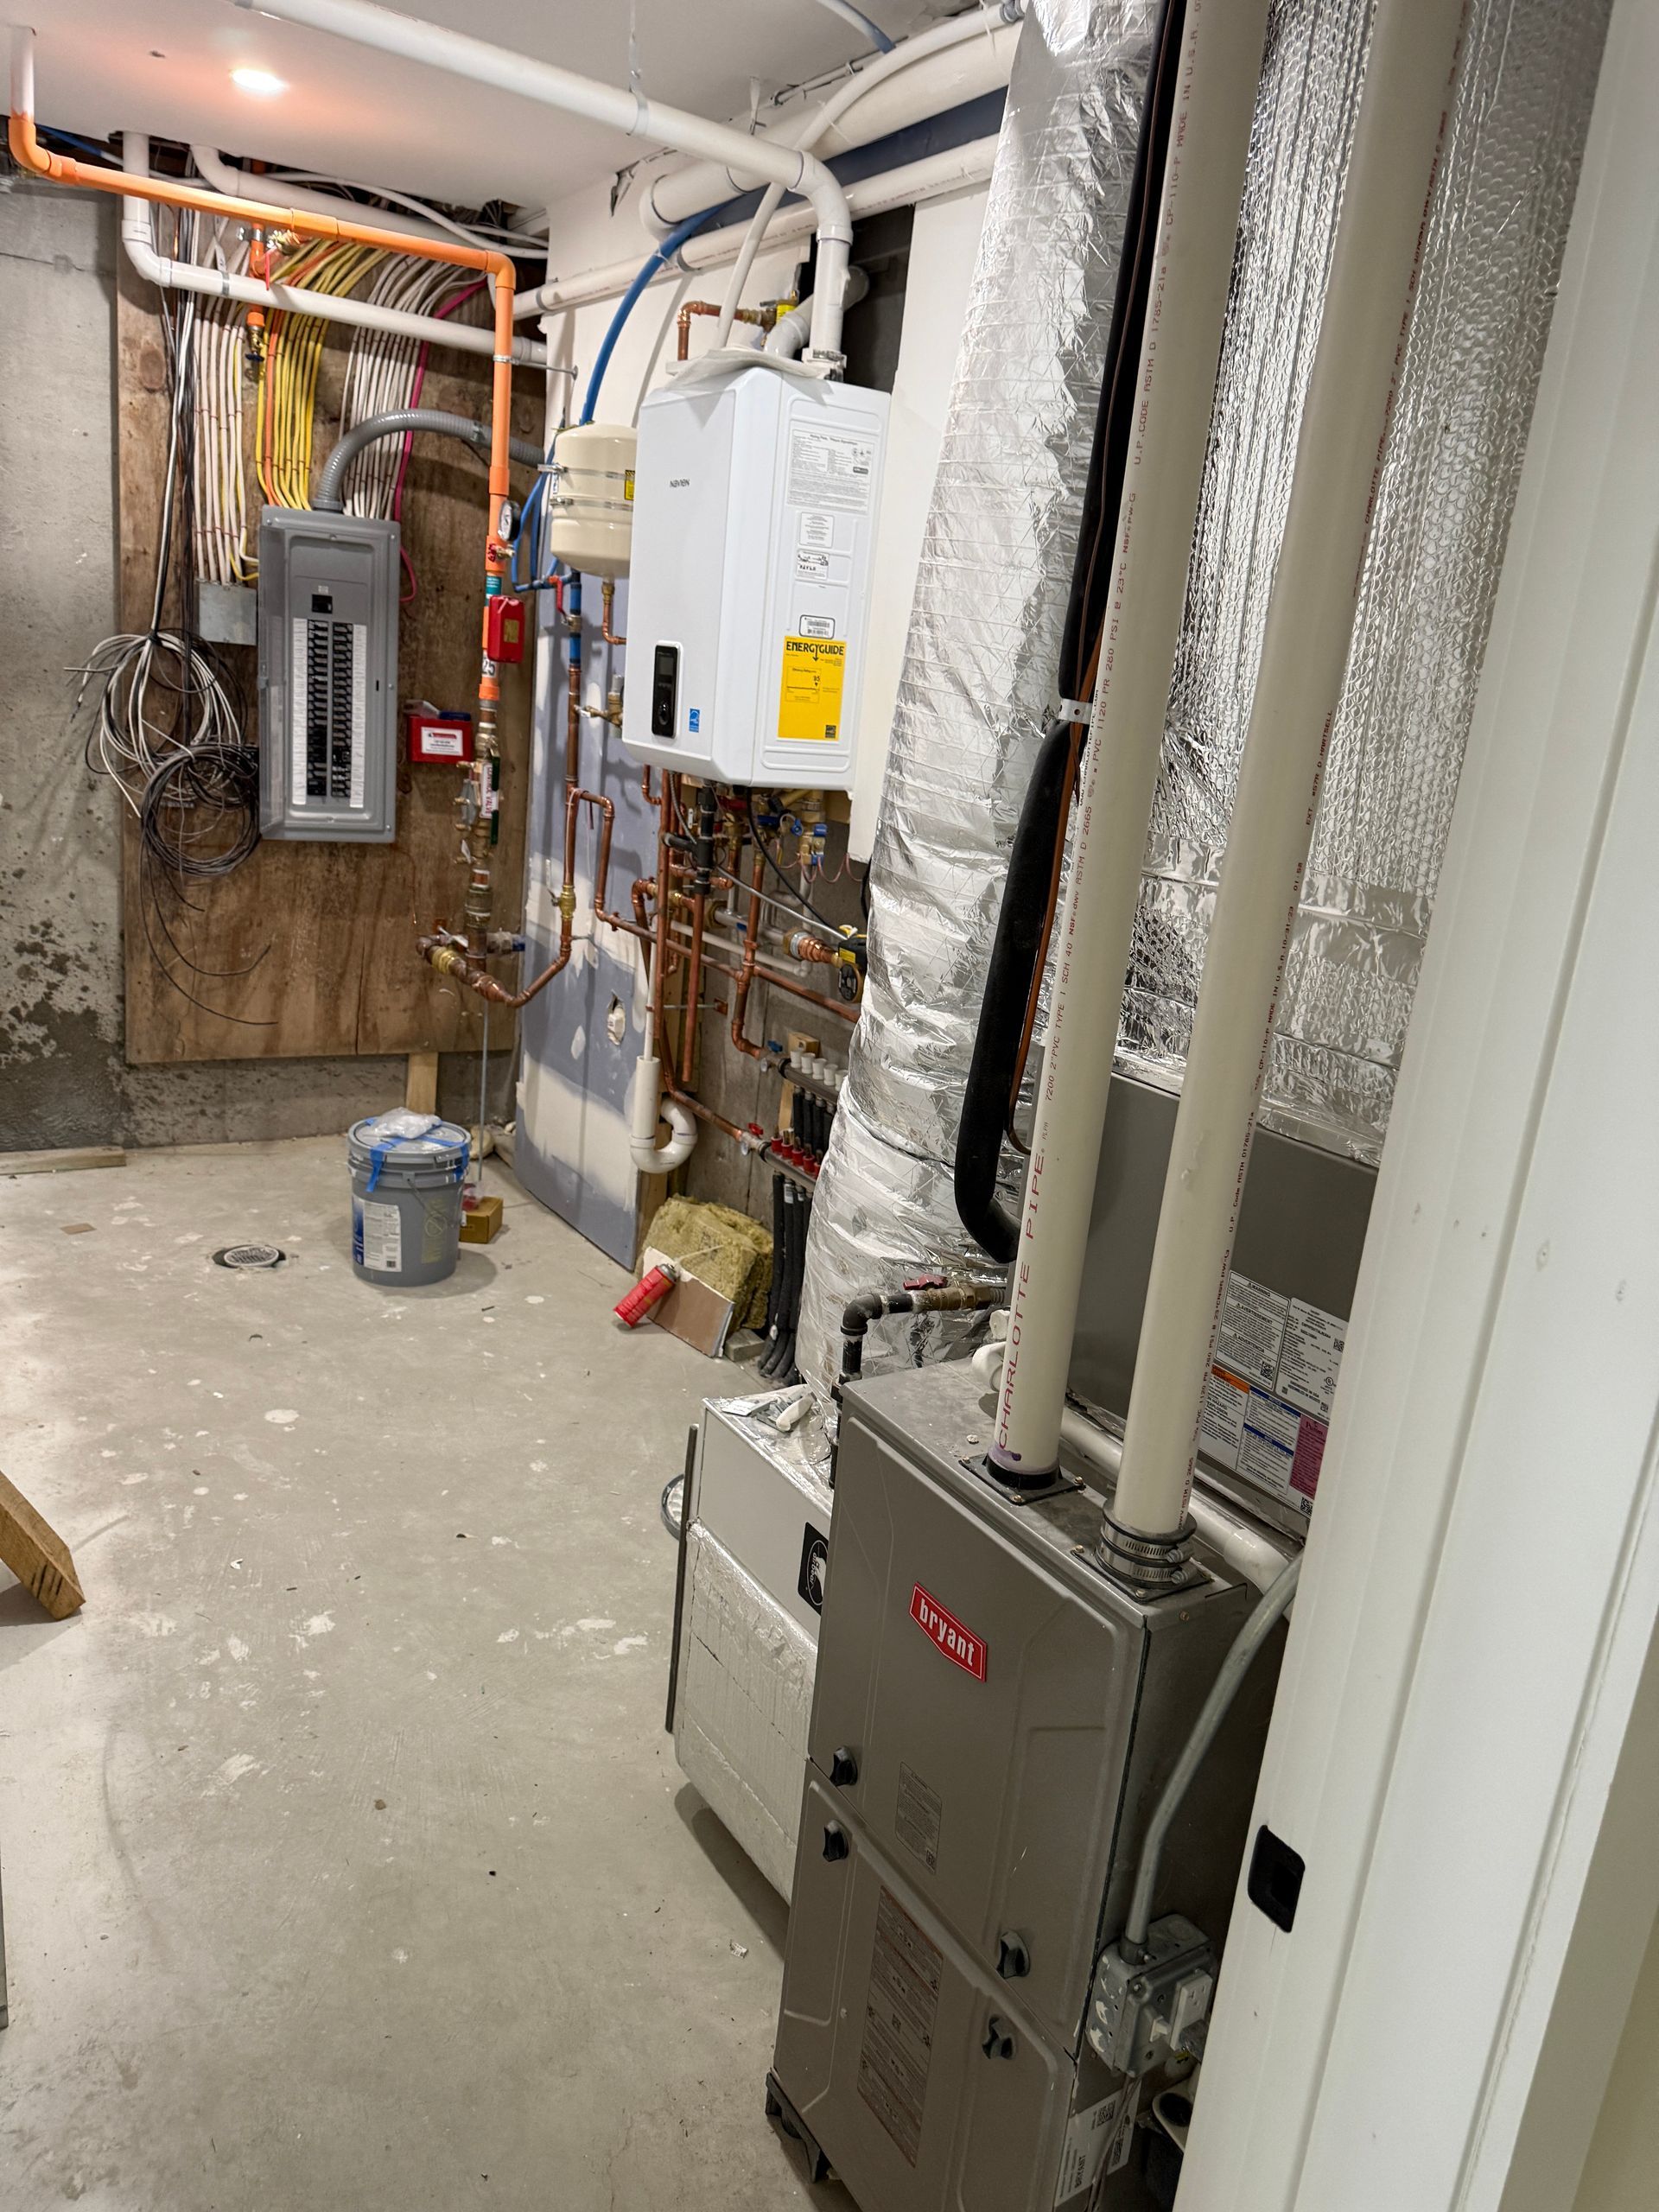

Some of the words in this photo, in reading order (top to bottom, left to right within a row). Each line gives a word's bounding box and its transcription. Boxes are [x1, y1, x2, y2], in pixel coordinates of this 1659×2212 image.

[1181, 83, 1192, 101] IN
[1176, 111, 1187, 147] MADE
[1164, 156, 1182, 226] CP-110-P
[1407, 269, 1417, 291] SCH
[1150, 265, 1167, 332] 1785-21a
[1398, 310, 1408, 337] TYPE
[1148, 341, 1157, 351] D
[1393, 342, 1402, 365] PVC
[1142, 357, 1154, 392] ASTM
[1363, 466, 1380, 524] CHARLOTTE
[1109, 618, 1119, 640] PSI
[786, 640, 844, 662] ENERGYGUIDE
[1104, 647, 1115, 671] 280
[1101, 677, 1110, 694] PR
[1096, 701, 1107, 730] 1120
[1091, 738, 1102, 761] PVC
[1081, 805, 1092, 836] 2665
[1079, 841, 1087, 850] D
[1074, 855, 1085, 885] ASTM
[1065, 942, 1073, 957] 40
[1060, 962, 1070, 984] SCH
[1272, 985, 1279, 996] IN
[1054, 1002, 1065, 1029] TYPE
[1267, 1001, 1275, 1023] MADE
[1045, 1075, 1055, 1101] 7200
[1236, 1160, 1245, 1183] ASTM
[1232, 1186, 1241, 1207] Code
[999, 1260, 1031, 1450] CHARLOTTE
[1202, 1370, 1209, 1382] PR
[1198, 1384, 1206, 1404] 1120
[919, 1597, 975, 1667] bryant
